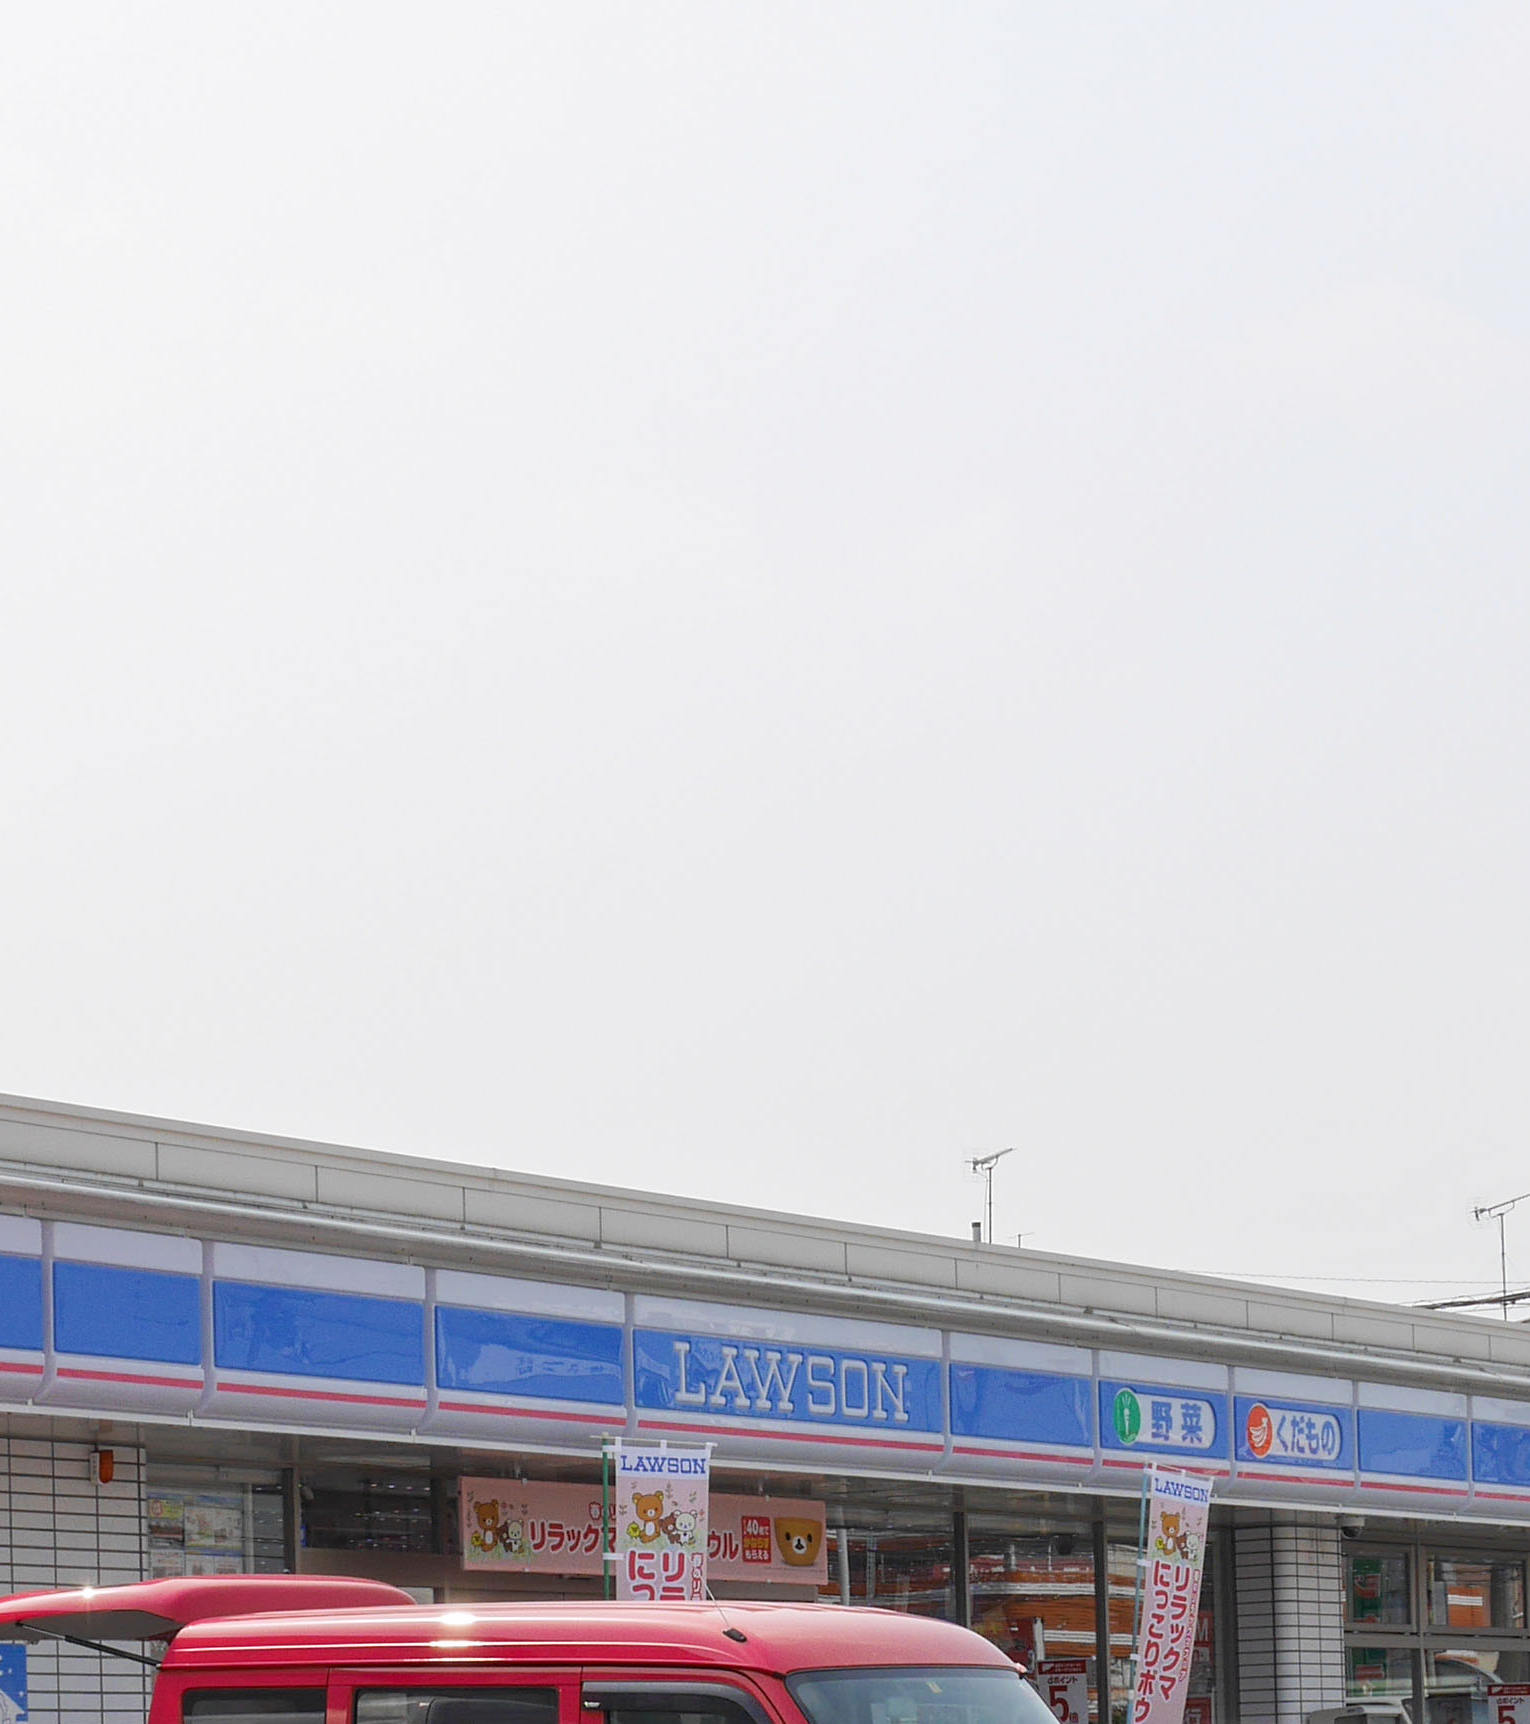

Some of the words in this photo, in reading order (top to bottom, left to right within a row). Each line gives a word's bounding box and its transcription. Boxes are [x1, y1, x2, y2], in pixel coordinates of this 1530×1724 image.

[673, 1341, 909, 1423] LAWSON
[1151, 1401, 1204, 1444] 野菜
[1277, 1415, 1336, 1455] くだもの
[621, 1456, 706, 1474] LAWSON
[1155, 1478, 1209, 1503] LAWSON
[1159, 1565, 1190, 1700] リラックマ
